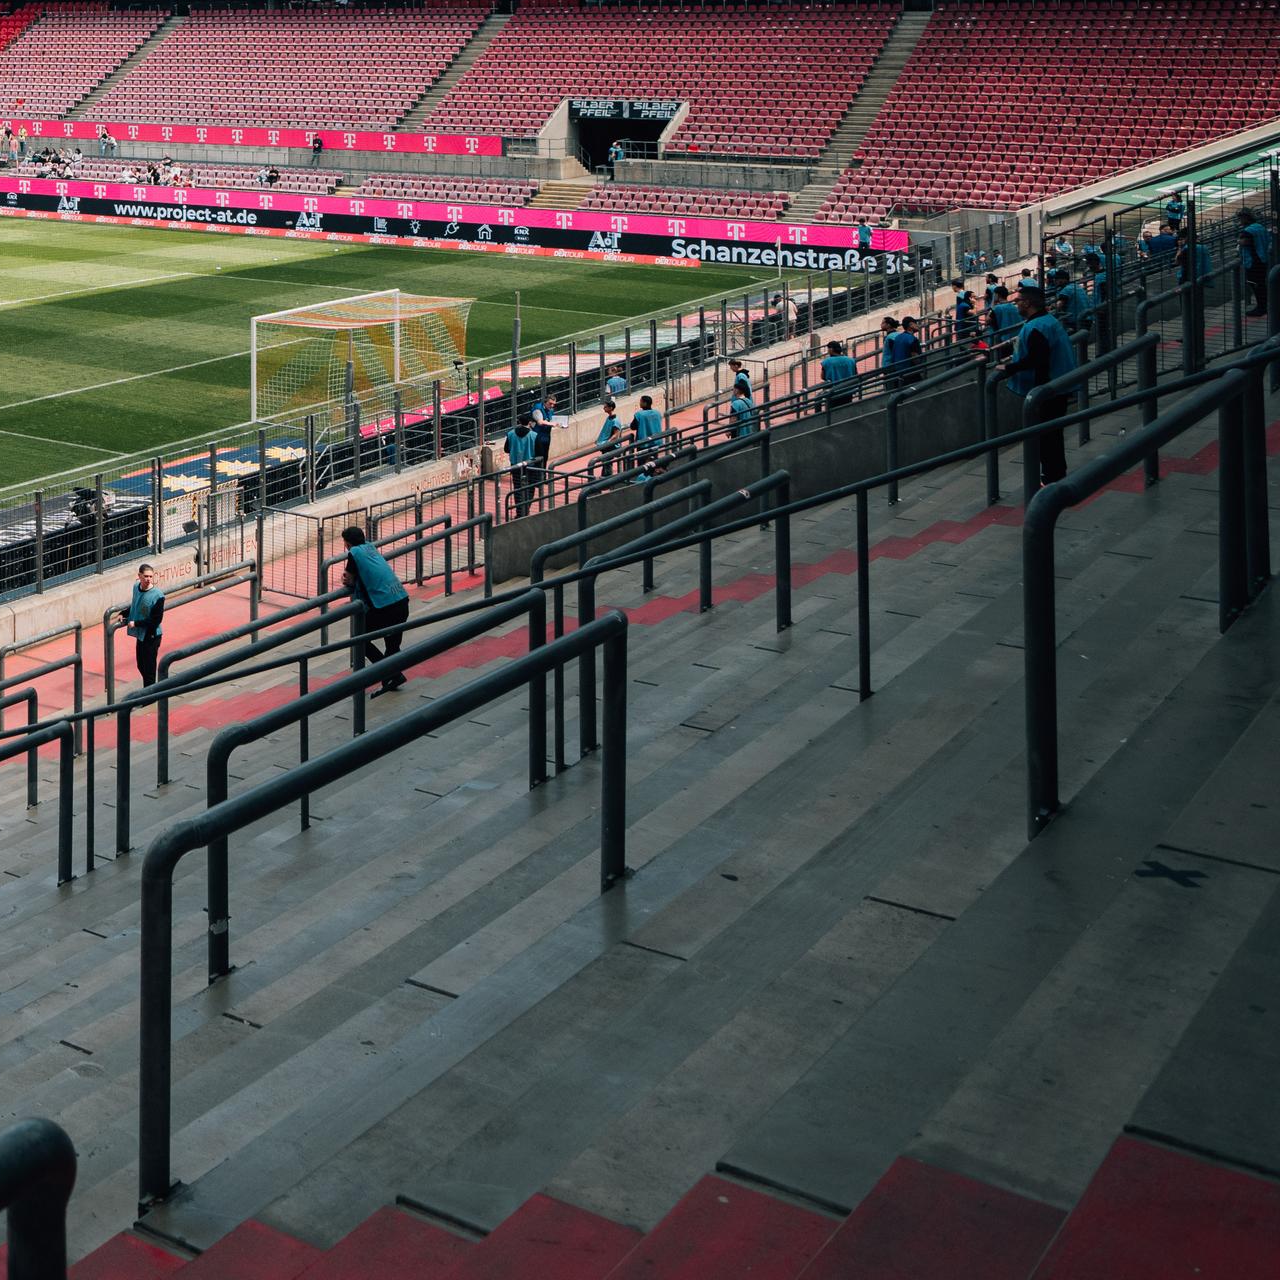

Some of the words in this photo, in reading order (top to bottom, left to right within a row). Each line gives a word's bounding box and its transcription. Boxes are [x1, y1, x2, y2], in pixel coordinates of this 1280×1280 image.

[572, 101, 614, 109] SILBER
[633, 102, 677, 110] SILBER
[580, 109, 611, 117] PFEIL
[640, 110, 674, 118] PFEIL
[162, 126, 172, 141] T
[232, 129, 243, 144] T
[344, 133, 356, 148] T
[424, 136, 437, 152] T
[19, 180, 30, 193] T
[173, 189, 187, 204] T
[114, 203, 257, 225] www.project-at.de
[350, 200, 365, 215] T
[447, 206, 463, 222] T
[556, 213, 573, 229] T
[611, 216, 629, 232] T
[667, 219, 686, 236] T
[727, 222, 746, 240] T
[789, 226, 807, 244] T
[369, 236, 397, 245] DERTOUR
[413, 239, 441, 248] DERTOUR
[458, 242, 487, 251] DERTOUR
[505, 245, 535, 255] DERTOUR
[553, 249, 584, 259] DERTOUR
[604, 252, 635, 263] DERTOUR
[672, 239, 876, 271] Schanzenstraße
[655, 256, 687, 267] DERTOUR
[152, 561, 192, 585] CHTWEG
